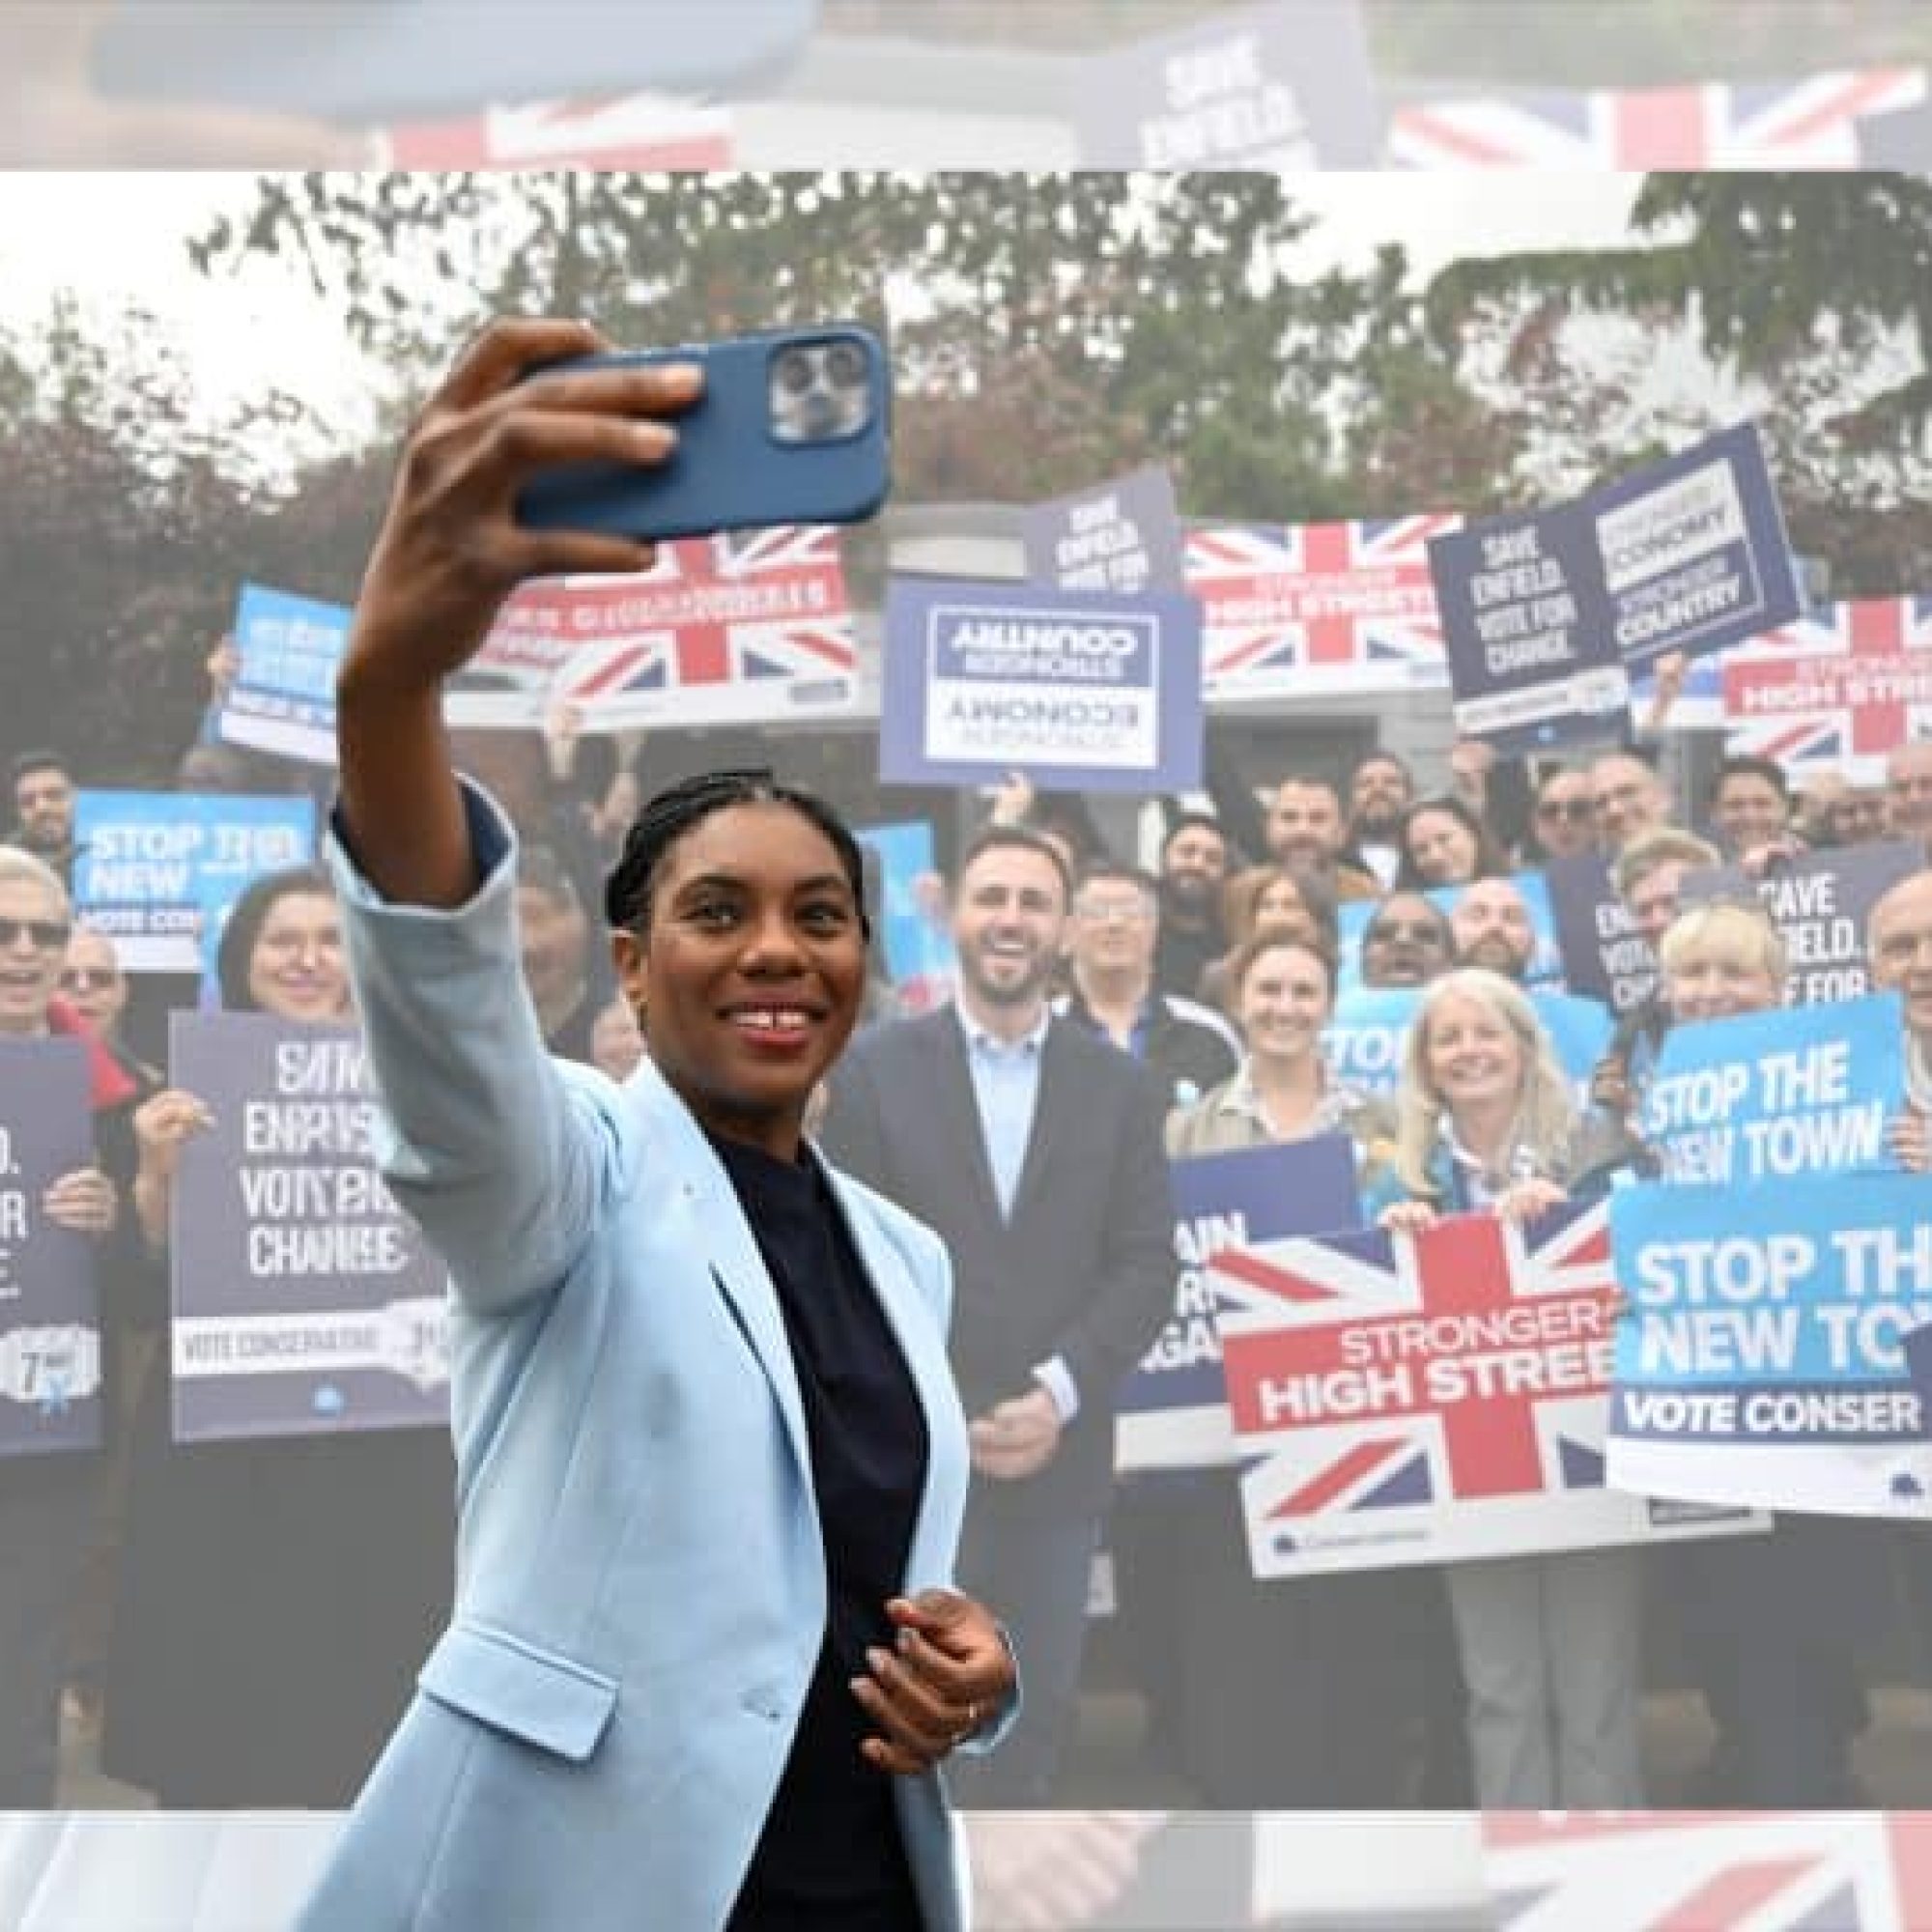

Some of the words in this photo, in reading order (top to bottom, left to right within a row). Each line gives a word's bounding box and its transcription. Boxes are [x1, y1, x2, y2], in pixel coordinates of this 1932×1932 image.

[1482, 525, 1540, 569] SAVE
[1206, 595, 1300, 626] HIGH
[1474, 603, 1529, 642] VOTE
[1531, 593, 1577, 630] FOR
[1614, 576, 1743, 645] COUNTRY
[949, 621, 1140, 656] COUNTRY
[946, 697, 1140, 728] ECONOMY
[1742, 674, 1840, 714] HIGH
[91, 822, 204, 860] STOP
[88, 862, 188, 901] NEW
[1650, 1065, 1748, 1134] STOP
[1757, 1040, 1850, 1112] THE
[1745, 1097, 1883, 1175] TOWN
[1635, 1234, 1815, 1305] STOP
[1831, 1225, 1932, 1296] TH
[1339, 1297, 1599, 1364] STRONGER
[1643, 1307, 1800, 1374] NEW
[1814, 1300, 1932, 1373] TO
[1258, 1370, 1414, 1422] HIGH
[1624, 1391, 1737, 1432] VOTE
[1745, 1391, 1922, 1432] CONSER
